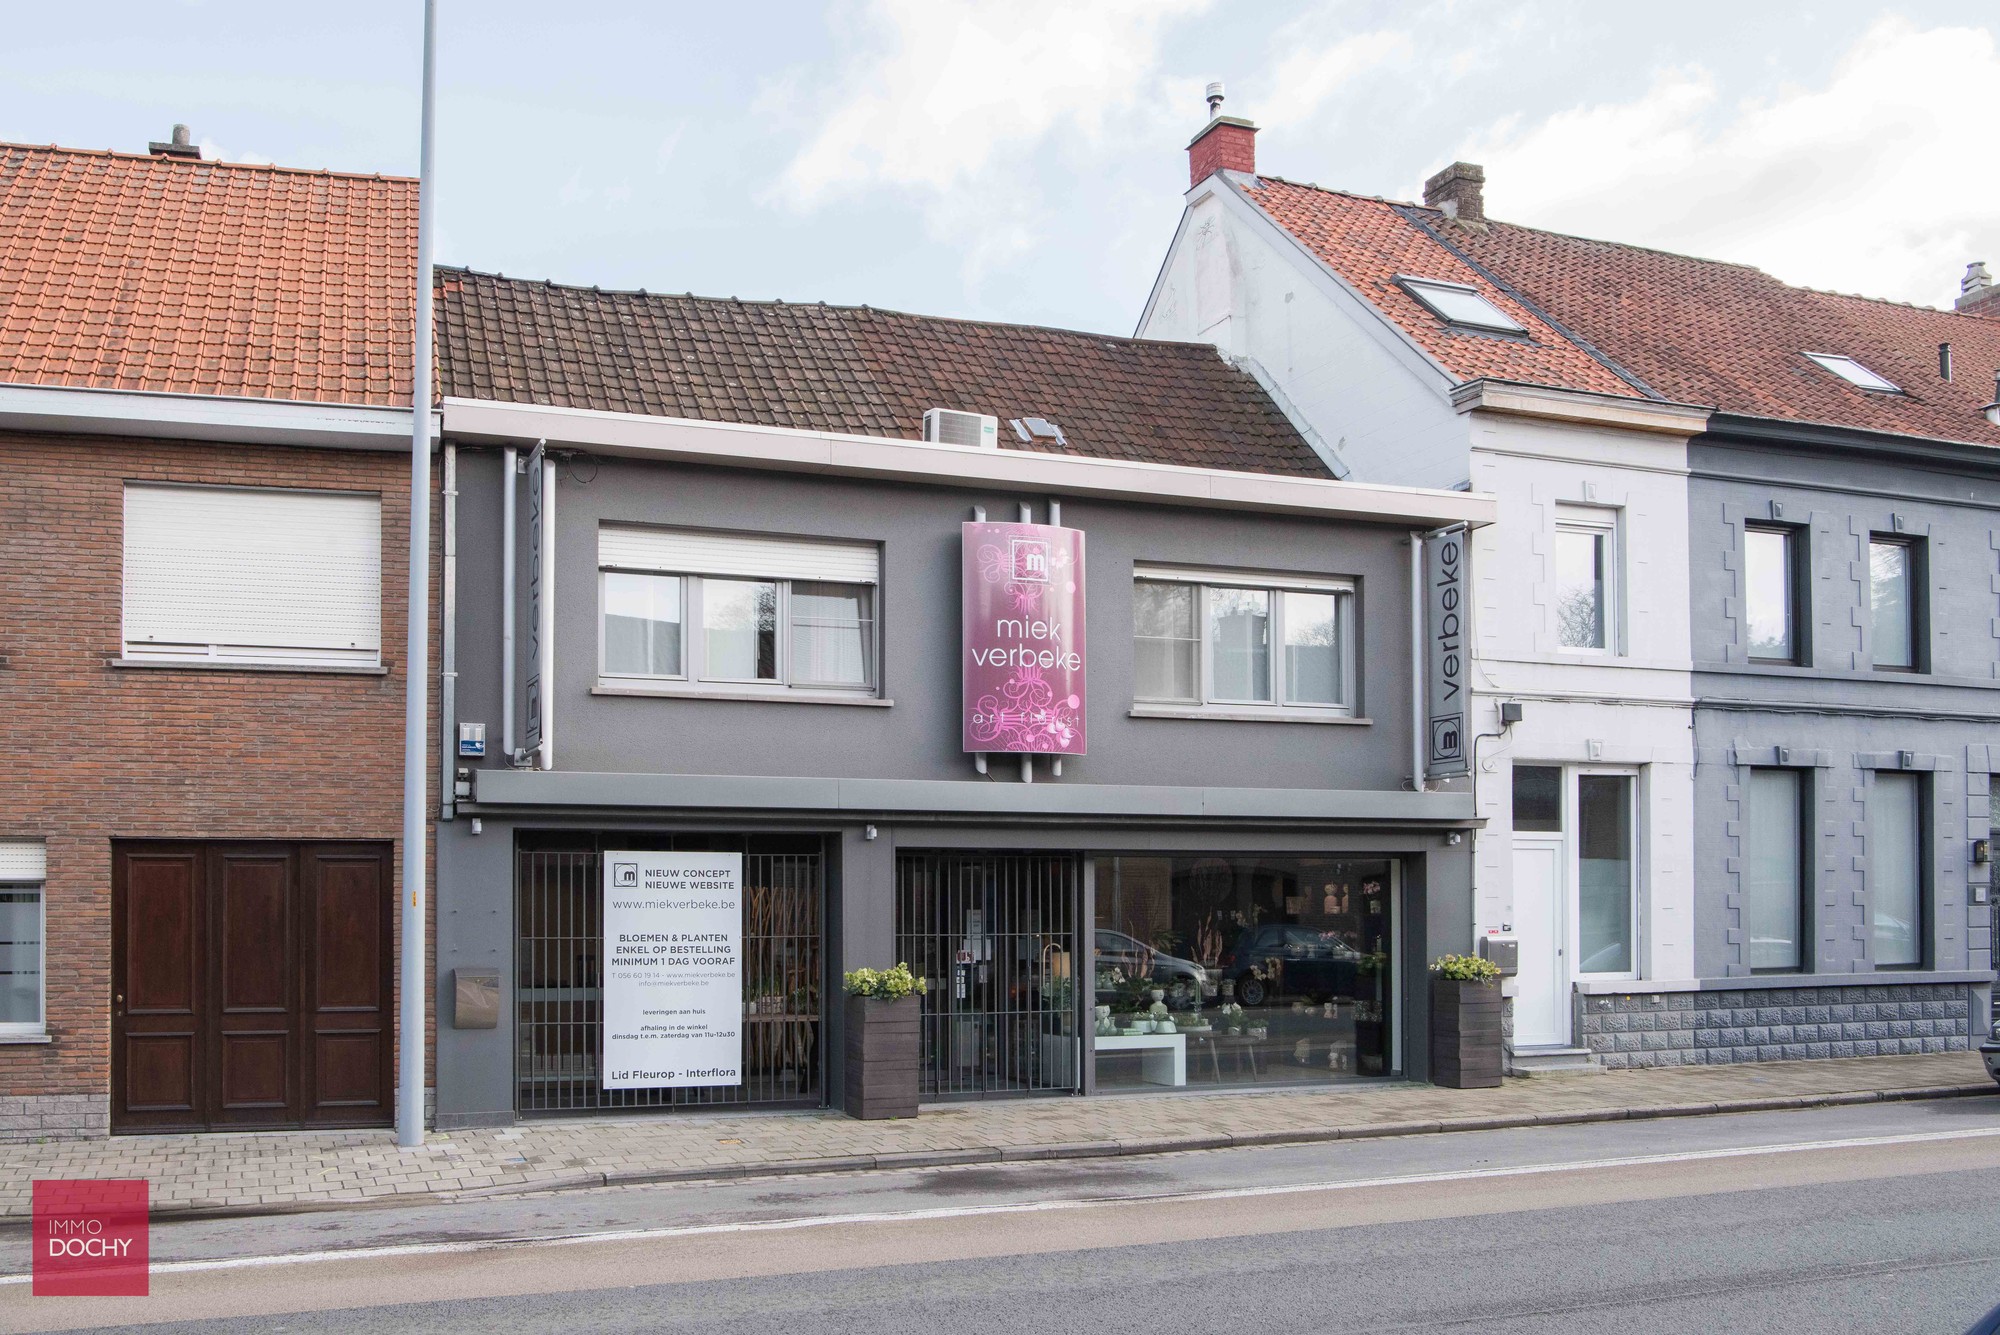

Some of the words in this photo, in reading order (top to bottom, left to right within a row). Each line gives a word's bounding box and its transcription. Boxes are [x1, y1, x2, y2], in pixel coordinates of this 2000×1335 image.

[1026, 553, 1045, 572] m
[1437, 542, 1460, 701] verbeke
[997, 614, 1061, 641] miek
[972, 643, 1081, 671] verbeke
[973, 712, 1005, 724] art
[623, 871, 636, 881] m
[645, 869, 680, 878] NIEUW
[683, 870, 731, 878] CONCEPT
[689, 881, 734, 890] WEBSITE
[612, 899, 736, 909] www.miekverbeke.be
[619, 934, 669, 942] BLOEMEN
[671, 934, 678, 942] &
[681, 934, 728, 942] PLANTEN
[616, 946, 649, 954] ENKEL
[652, 946, 667, 954] OP
[670, 945, 731, 954] BESTELLING
[611, 958, 658, 966] MINIMUM
[661, 958, 665, 966] 1
[668, 958, 690, 966] DAG
[692, 957, 735, 966] VOORAF
[660, 1032, 690, 1040] zaterdag
[611, 1070, 629, 1080] Lid
[632, 1070, 675, 1080] Fleurop
[686, 1067, 736, 1078] Interflora
